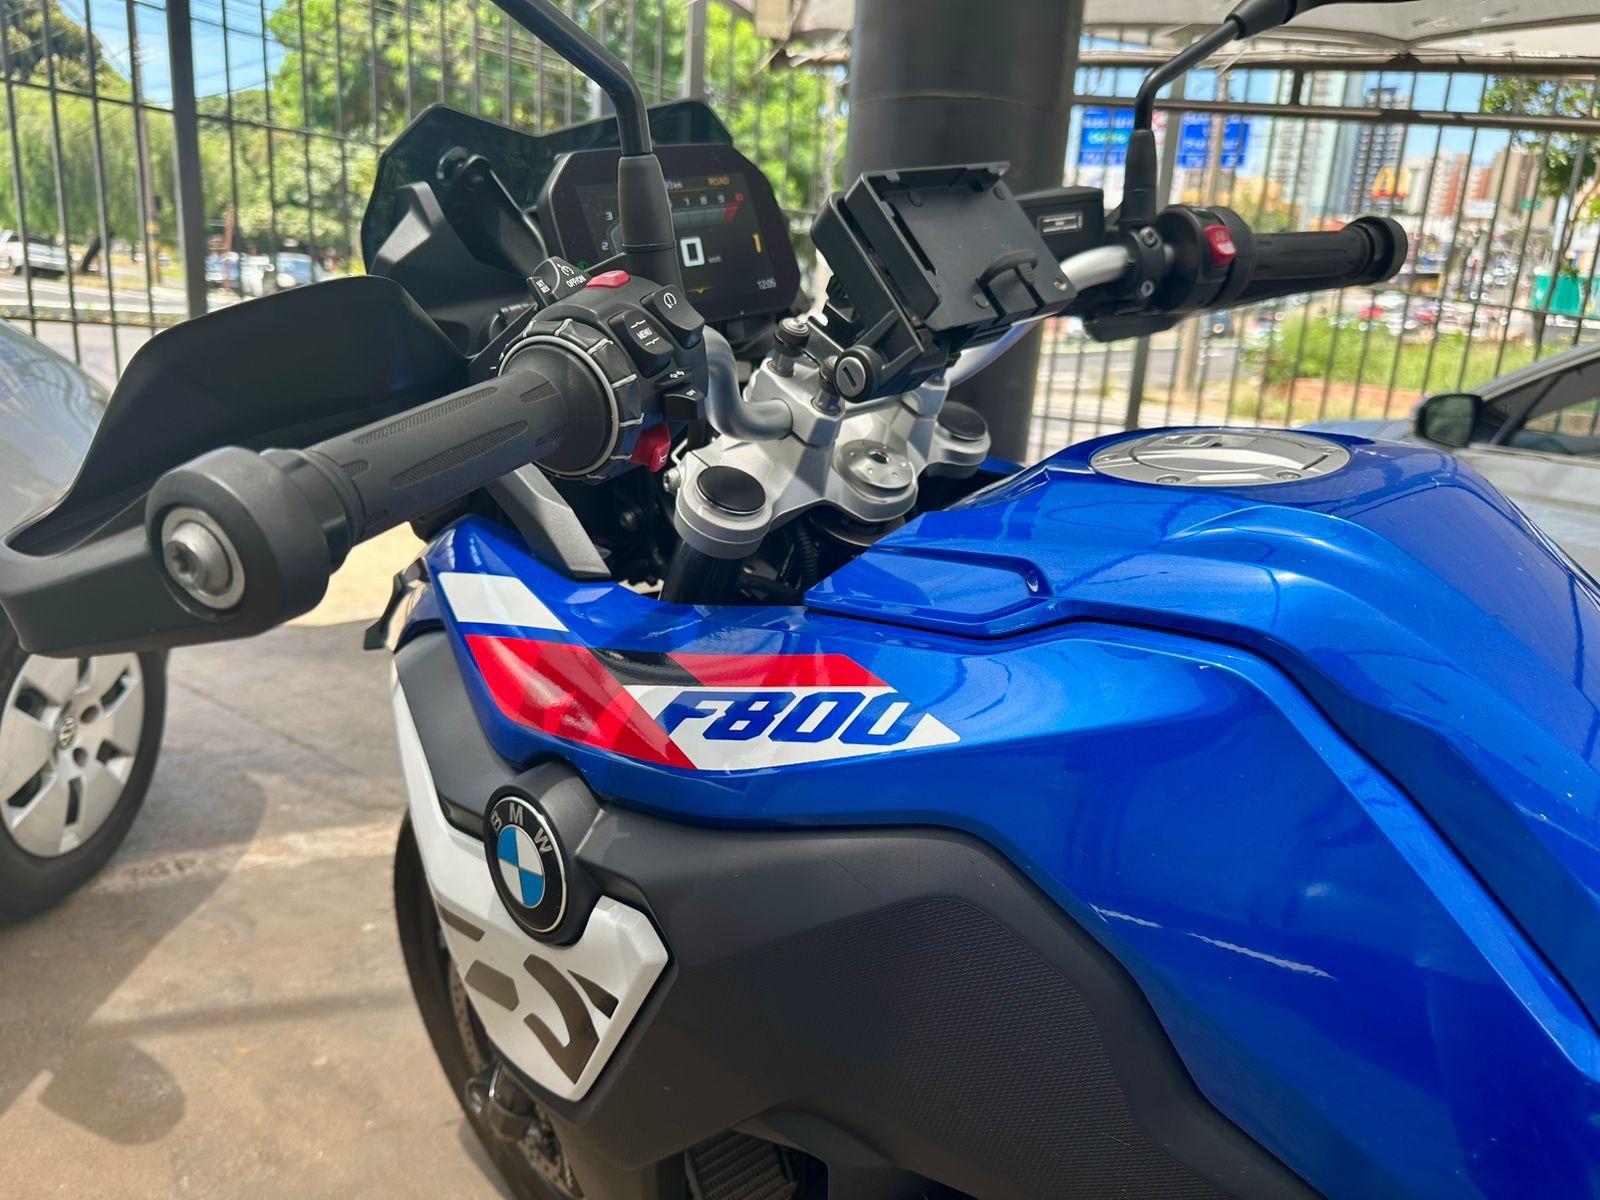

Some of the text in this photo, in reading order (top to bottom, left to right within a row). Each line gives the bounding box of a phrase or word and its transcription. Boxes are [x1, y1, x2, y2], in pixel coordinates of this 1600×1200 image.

[680, 236, 705, 268] 0
[636, 327, 653, 340] MENU
[490, 802, 553, 853] BMW
